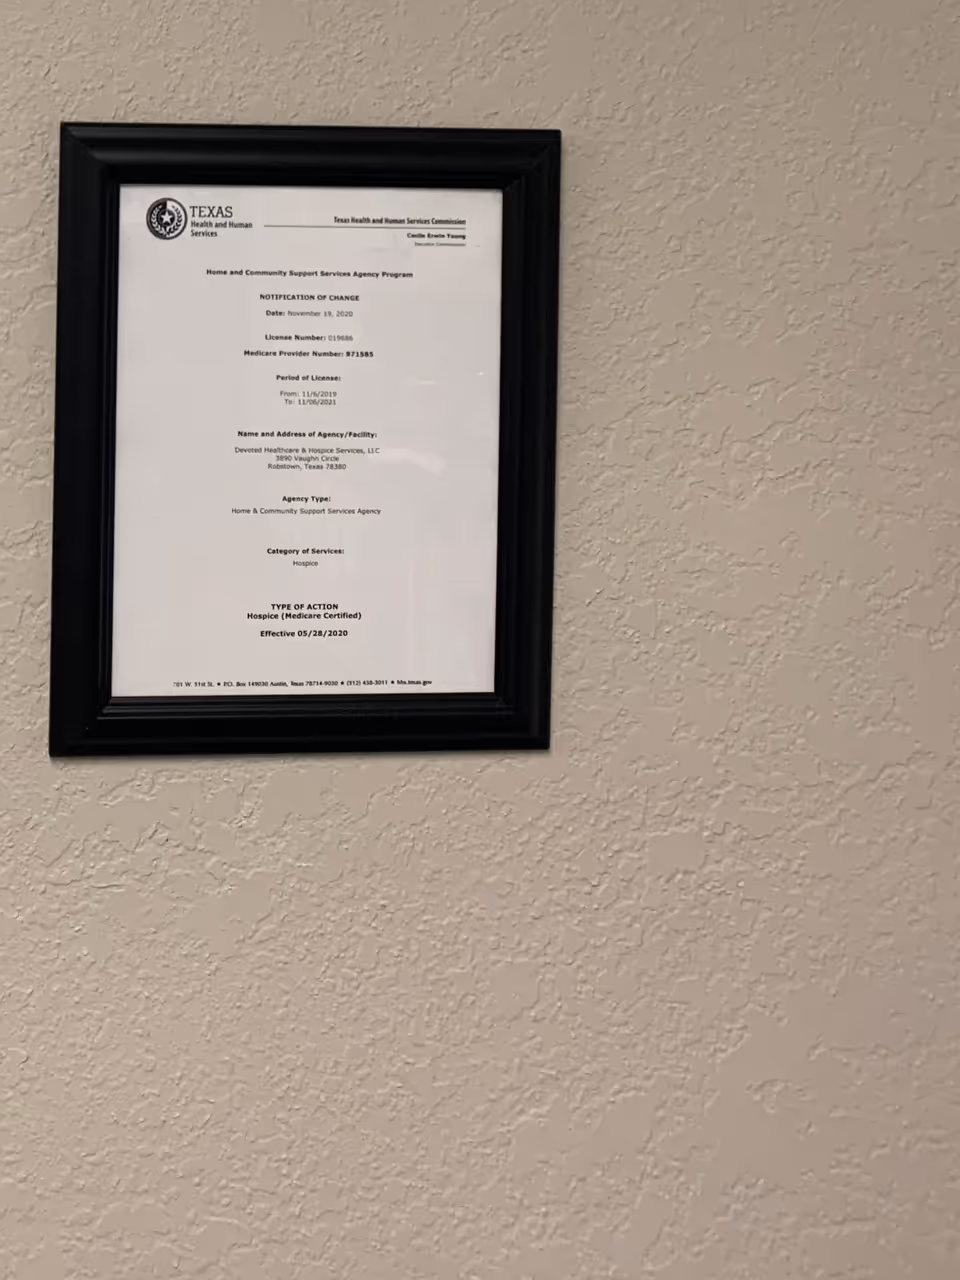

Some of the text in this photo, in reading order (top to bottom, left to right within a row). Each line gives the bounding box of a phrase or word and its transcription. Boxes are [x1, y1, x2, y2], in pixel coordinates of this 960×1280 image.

[189, 206, 233, 218] TEXAS
[191, 221, 213, 229] Health
[190, 229, 217, 237] Services
[247, 612, 361, 620] Hospice (Medicare Certified)
